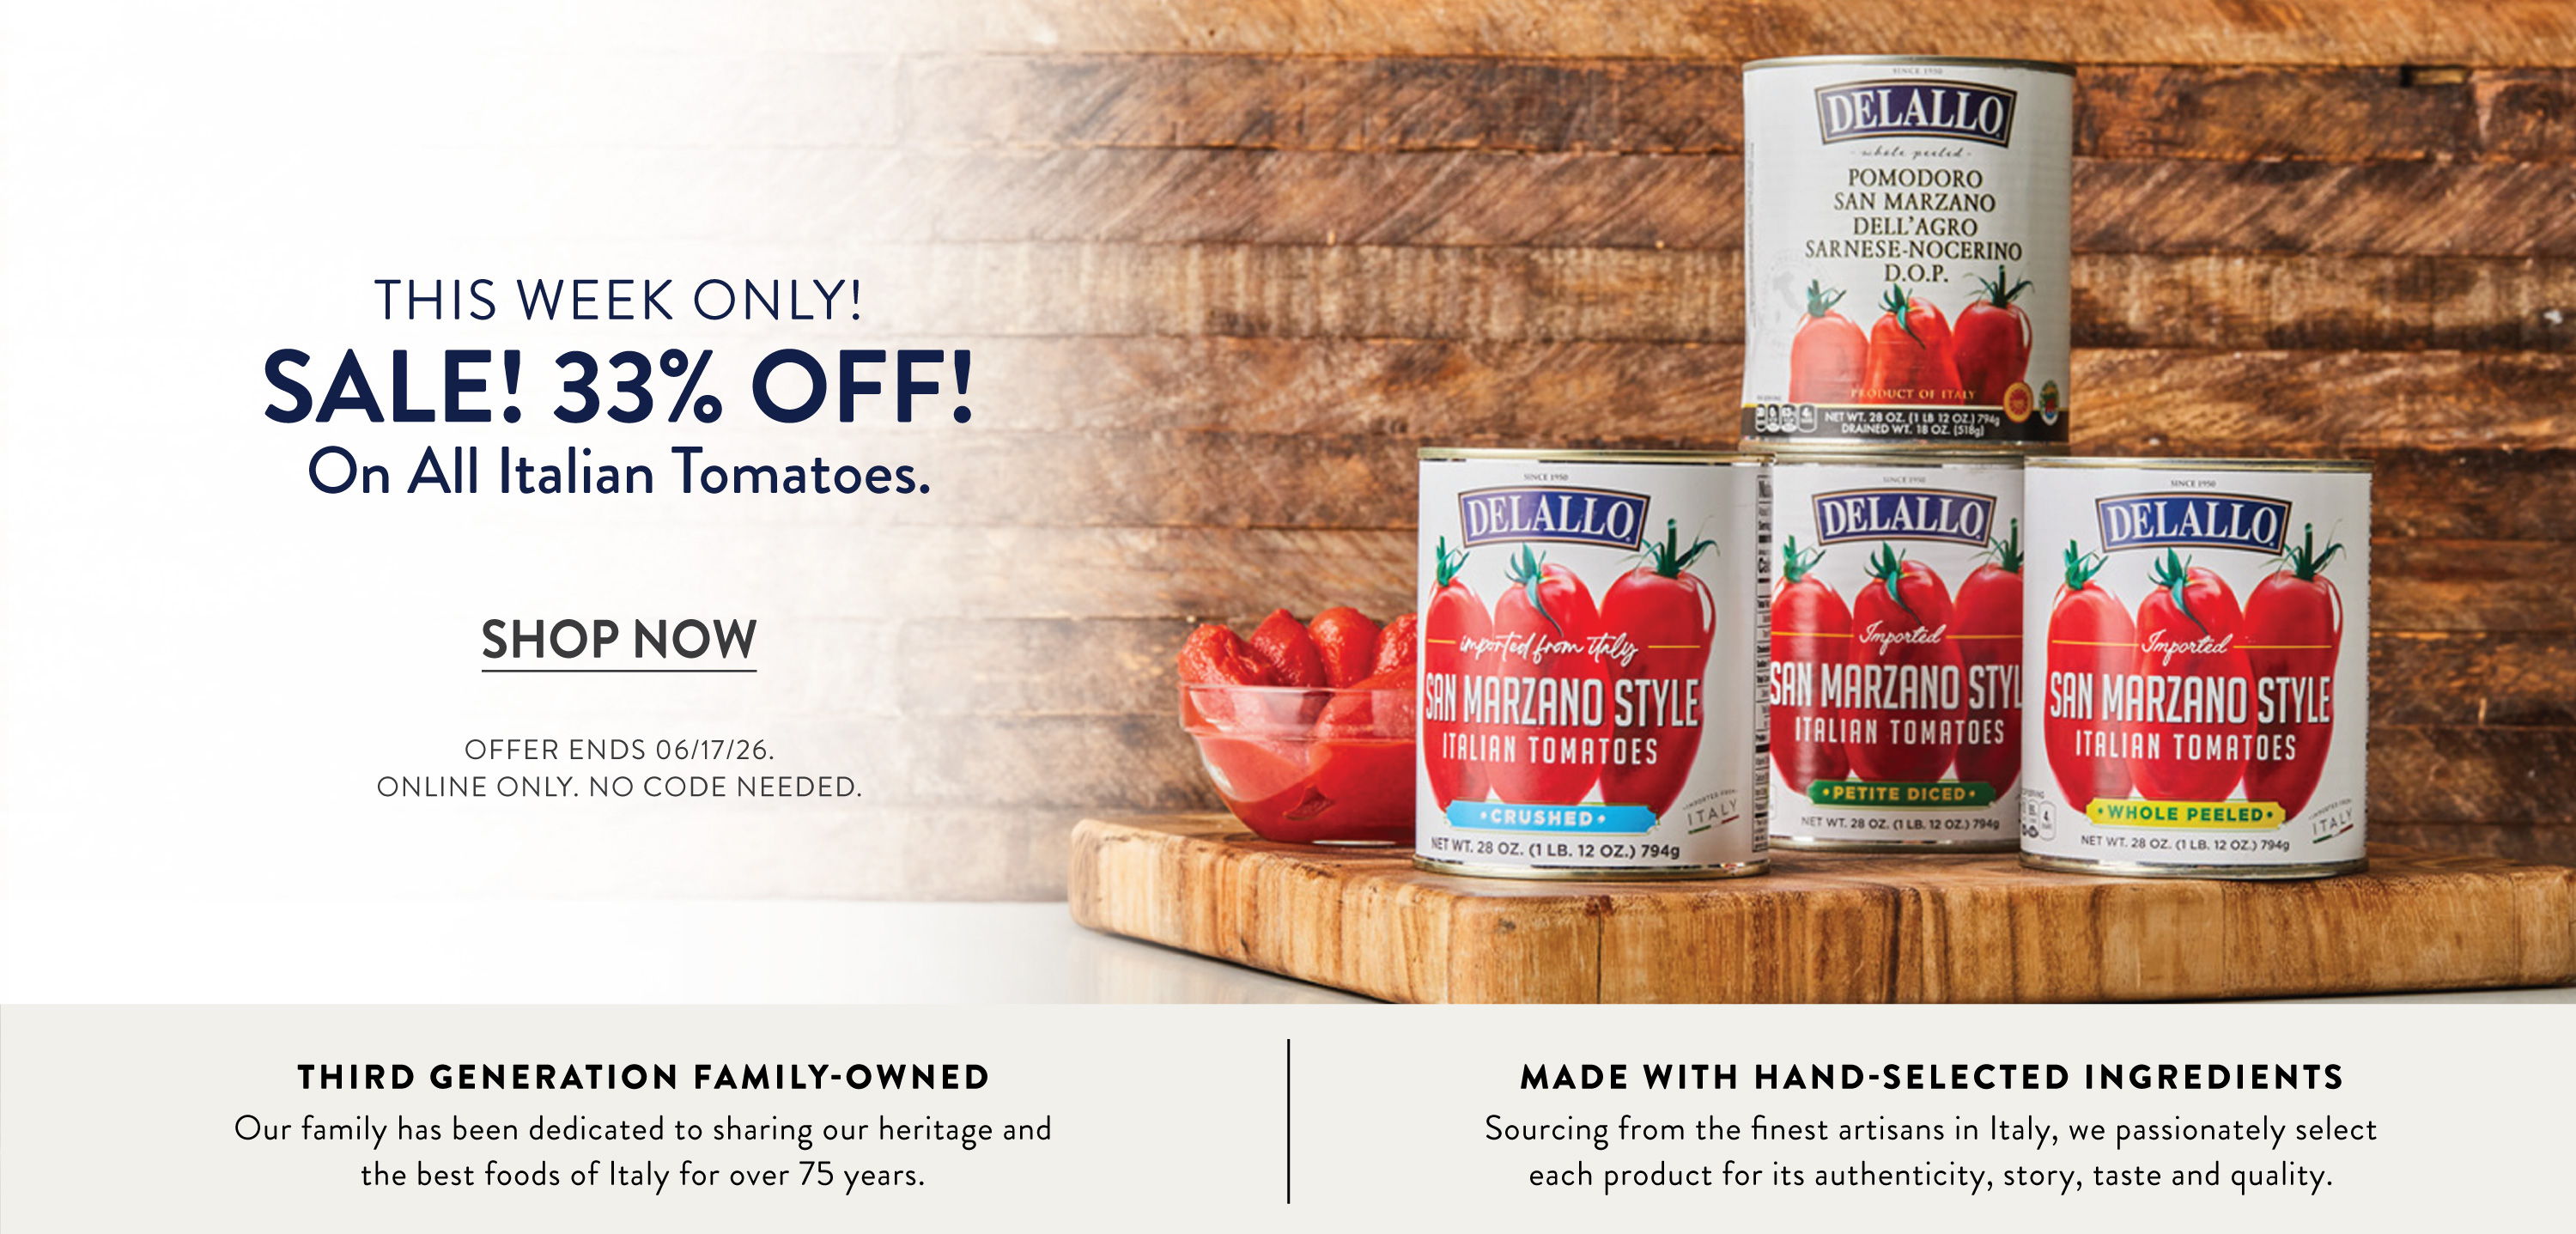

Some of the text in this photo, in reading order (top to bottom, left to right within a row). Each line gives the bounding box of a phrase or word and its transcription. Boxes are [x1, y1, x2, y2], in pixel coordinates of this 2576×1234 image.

[1825, 88, 2005, 135] DELALLO
[1848, 168, 1983, 188] POMODORO
[1834, 191, 1996, 212] SAN MARZANO
[1853, 216, 1978, 237] DELL'AGRO
[1805, 240, 2023, 261] SARNESE-NOCERINO
[1884, 264, 1949, 283] D.O.P.
[1850, 388, 1977, 399] PRODUCT OF ITALY
[1825, 412, 1844, 422] NET
[1846, 412, 1866, 422] WT.
[1869, 412, 1882, 422] 28
[1885, 412, 1905, 423] OZ.
[1909, 412, 1919, 424] (1
[1923, 413, 1934, 423] LB
[1938, 413, 1949, 423] 12
[1953, 413, 1975, 425] OZ.)
[1978, 414, 2000, 428] 794g
[1842, 423, 1984, 438] DRAINED WT. 18 OZ. (518g)
[1467, 494, 1635, 538] DELALLO
[1821, 495, 1984, 537] DELALLO
[2107, 501, 2278, 544] DELALLO
[1460, 631, 1536, 661] imported
[1533, 635, 1585, 665] from
[1859, 620, 1947, 656] Imported
[2141, 629, 2233, 666] Imported
[1770, 661, 1813, 707] SAN
[1821, 663, 1959, 710] MARZANO
[1968, 664, 2023, 709] STYL
[2050, 672, 2330, 724] SAN MARZANO STYLE
[1425, 672, 1457, 722] SAN
[1463, 674, 1603, 727] MARZANO
[1614, 678, 1700, 727] STYLE
[1795, 716, 2005, 745] ITALIAN TOMATOES
[1443, 732, 1658, 765] ITALIAN TOMATOES
[2075, 730, 2296, 760] ITALIAN TOMATOES
[1833, 786, 1966, 801] PETITE DICED
[1490, 807, 1593, 826] CRUSHED
[1688, 799, 1737, 826] ITALY
[1801, 817, 2000, 831] NET WT. 28 OZ. (1 LB. 12 OZ.) 794g
[2107, 805, 2263, 822] WHOLE PEELED
[2312, 807, 2352, 835] ITALY
[1431, 836, 1680, 860] NET WT. 28 OZ. (1 LB. 12 OZ.) 794g
[2081, 835, 2290, 852] NET WT. 28 OZ. (1 LB. 12 OZ.) 794g
